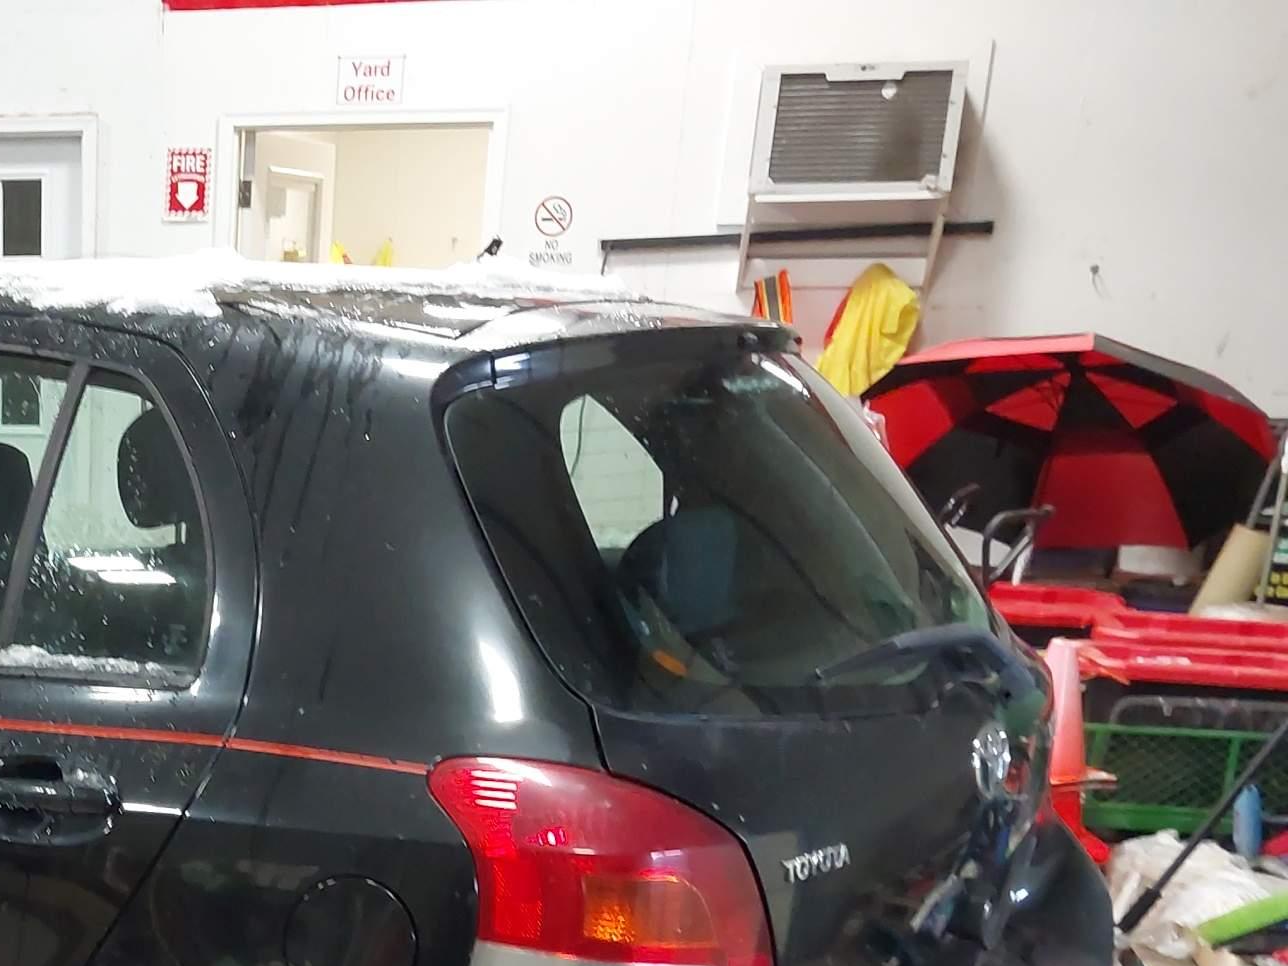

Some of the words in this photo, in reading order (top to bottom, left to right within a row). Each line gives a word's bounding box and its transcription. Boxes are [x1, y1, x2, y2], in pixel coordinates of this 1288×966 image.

[351, 59, 391, 78] Yard
[343, 84, 396, 102] Office
[172, 154, 206, 174] FIRE
[544, 239, 560, 250] NO
[528, 251, 573, 267] SMOKING
[779, 841, 851, 885] TOYOTA
